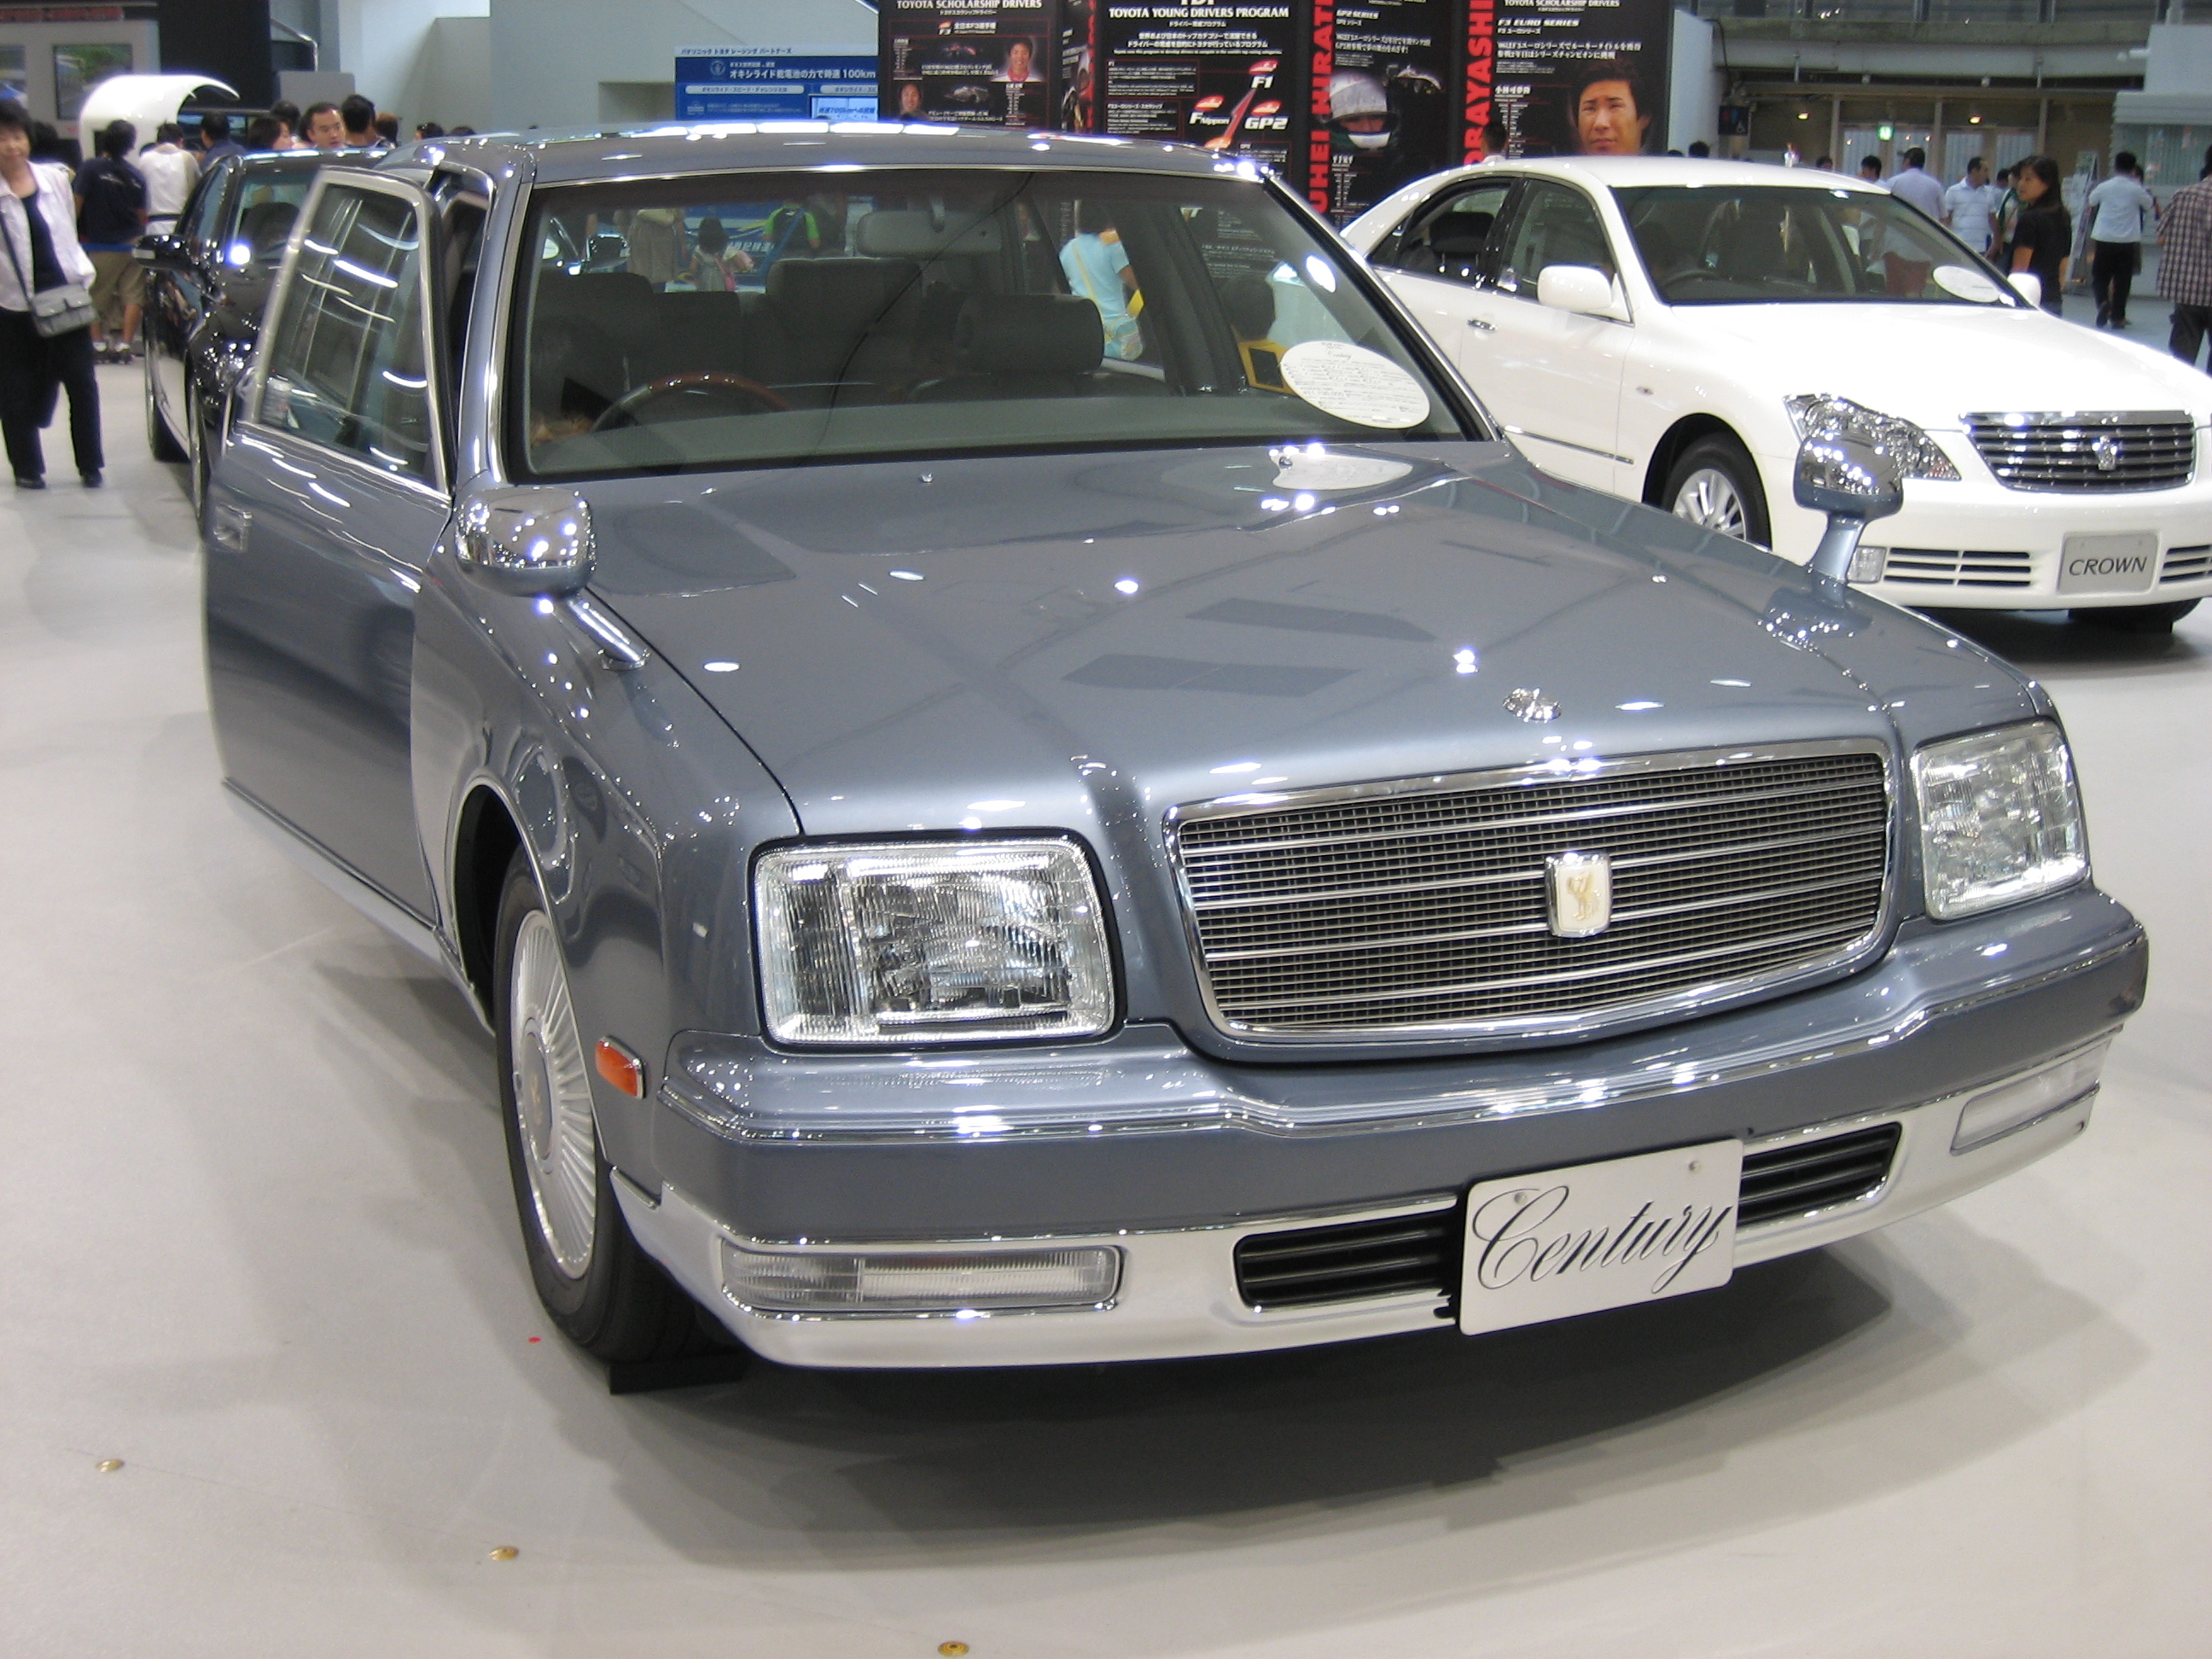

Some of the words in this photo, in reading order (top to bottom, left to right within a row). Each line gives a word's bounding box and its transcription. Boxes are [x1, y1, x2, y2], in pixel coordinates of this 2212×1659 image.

[897, 0, 934, 9] TOYOTA
[935, 0, 999, 9] SCHOLARSHIP
[1109, 8, 1150, 18] TOYOTA
[1152, 8, 1189, 18] YOUNG
[1190, 8, 1234, 18] DRIVERS
[1237, 8, 1289, 18] PROGRAM
[842, 69, 876, 79] 100km
[1251, 75, 1274, 89] F1
[1244, 116, 1289, 130] GP2
[2069, 556, 2147, 576] CROWN
[1472, 1185, 1733, 1294] Century
